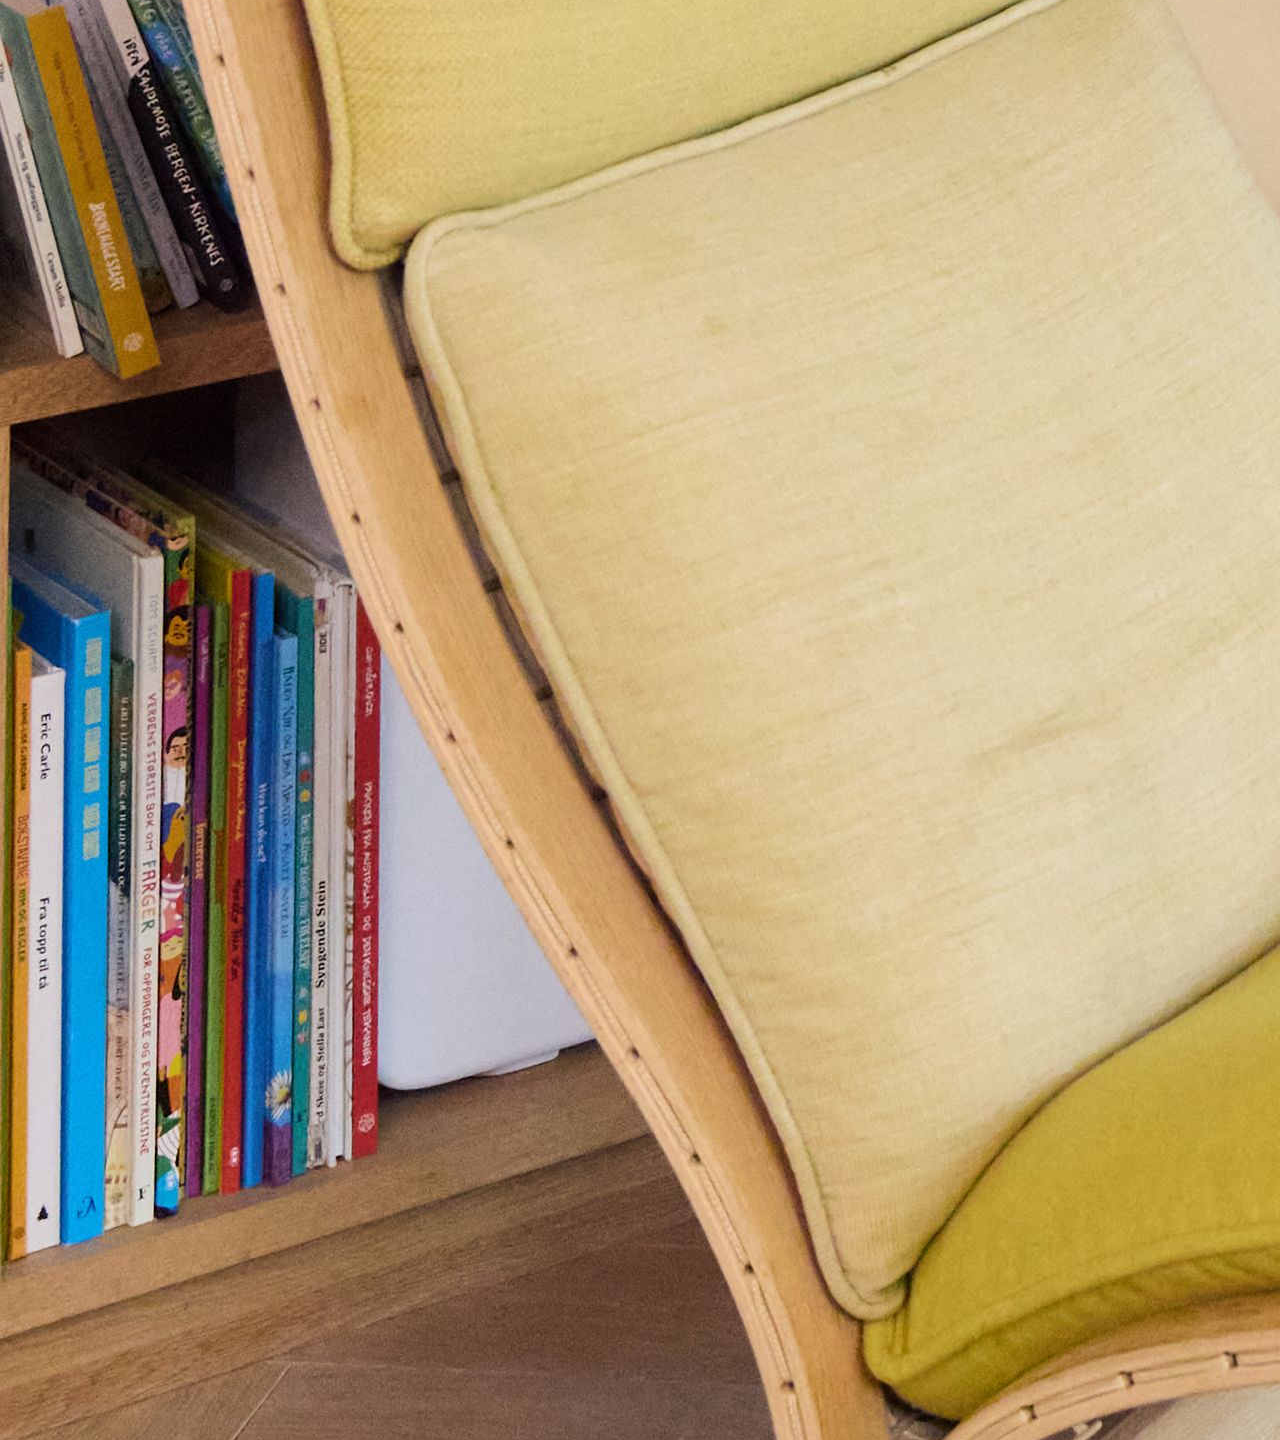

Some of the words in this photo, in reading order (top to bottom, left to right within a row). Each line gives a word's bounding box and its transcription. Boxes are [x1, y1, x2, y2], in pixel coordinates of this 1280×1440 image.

[123, 37, 141, 67] IBEN
[137, 68, 172, 140] SANDEMOSE
[164, 142, 225, 267] BERGEN-KIRKENES
[319, 632, 328, 654] EIDE
[40, 713, 52, 740] Eric
[145, 692, 157, 747] VERDENS
[40, 743, 52, 780] Carle
[146, 751, 156, 800] STØRSTE
[146, 803, 155, 827] BOK
[362, 781, 372, 825] PAKKEN
[146, 832, 155, 851] OM
[195, 822, 207, 879] Tornerose
[362, 829, 372, 849] FRA
[140, 860, 156, 934] FARGER
[362, 852, 372, 909] AUSTRALIA
[39, 897, 50, 919] Fra
[316, 881, 326, 916] Stein
[36, 923, 50, 955] topp
[363, 915, 371, 931] OG
[39, 957, 50, 972] til
[143, 947, 153, 969] FOR
[315, 920, 327, 989] Syngende
[39, 976, 50, 989] tå
[141, 973, 154, 1038] OPPDAGERE
[316, 1008, 326, 1029] East
[141, 1042, 151, 1058] OG
[316, 1032, 326, 1062] Stella
[361, 1010, 372, 1066] TEKANNEN
[139, 1061, 151, 1155] EVENTYRLYSTNE
